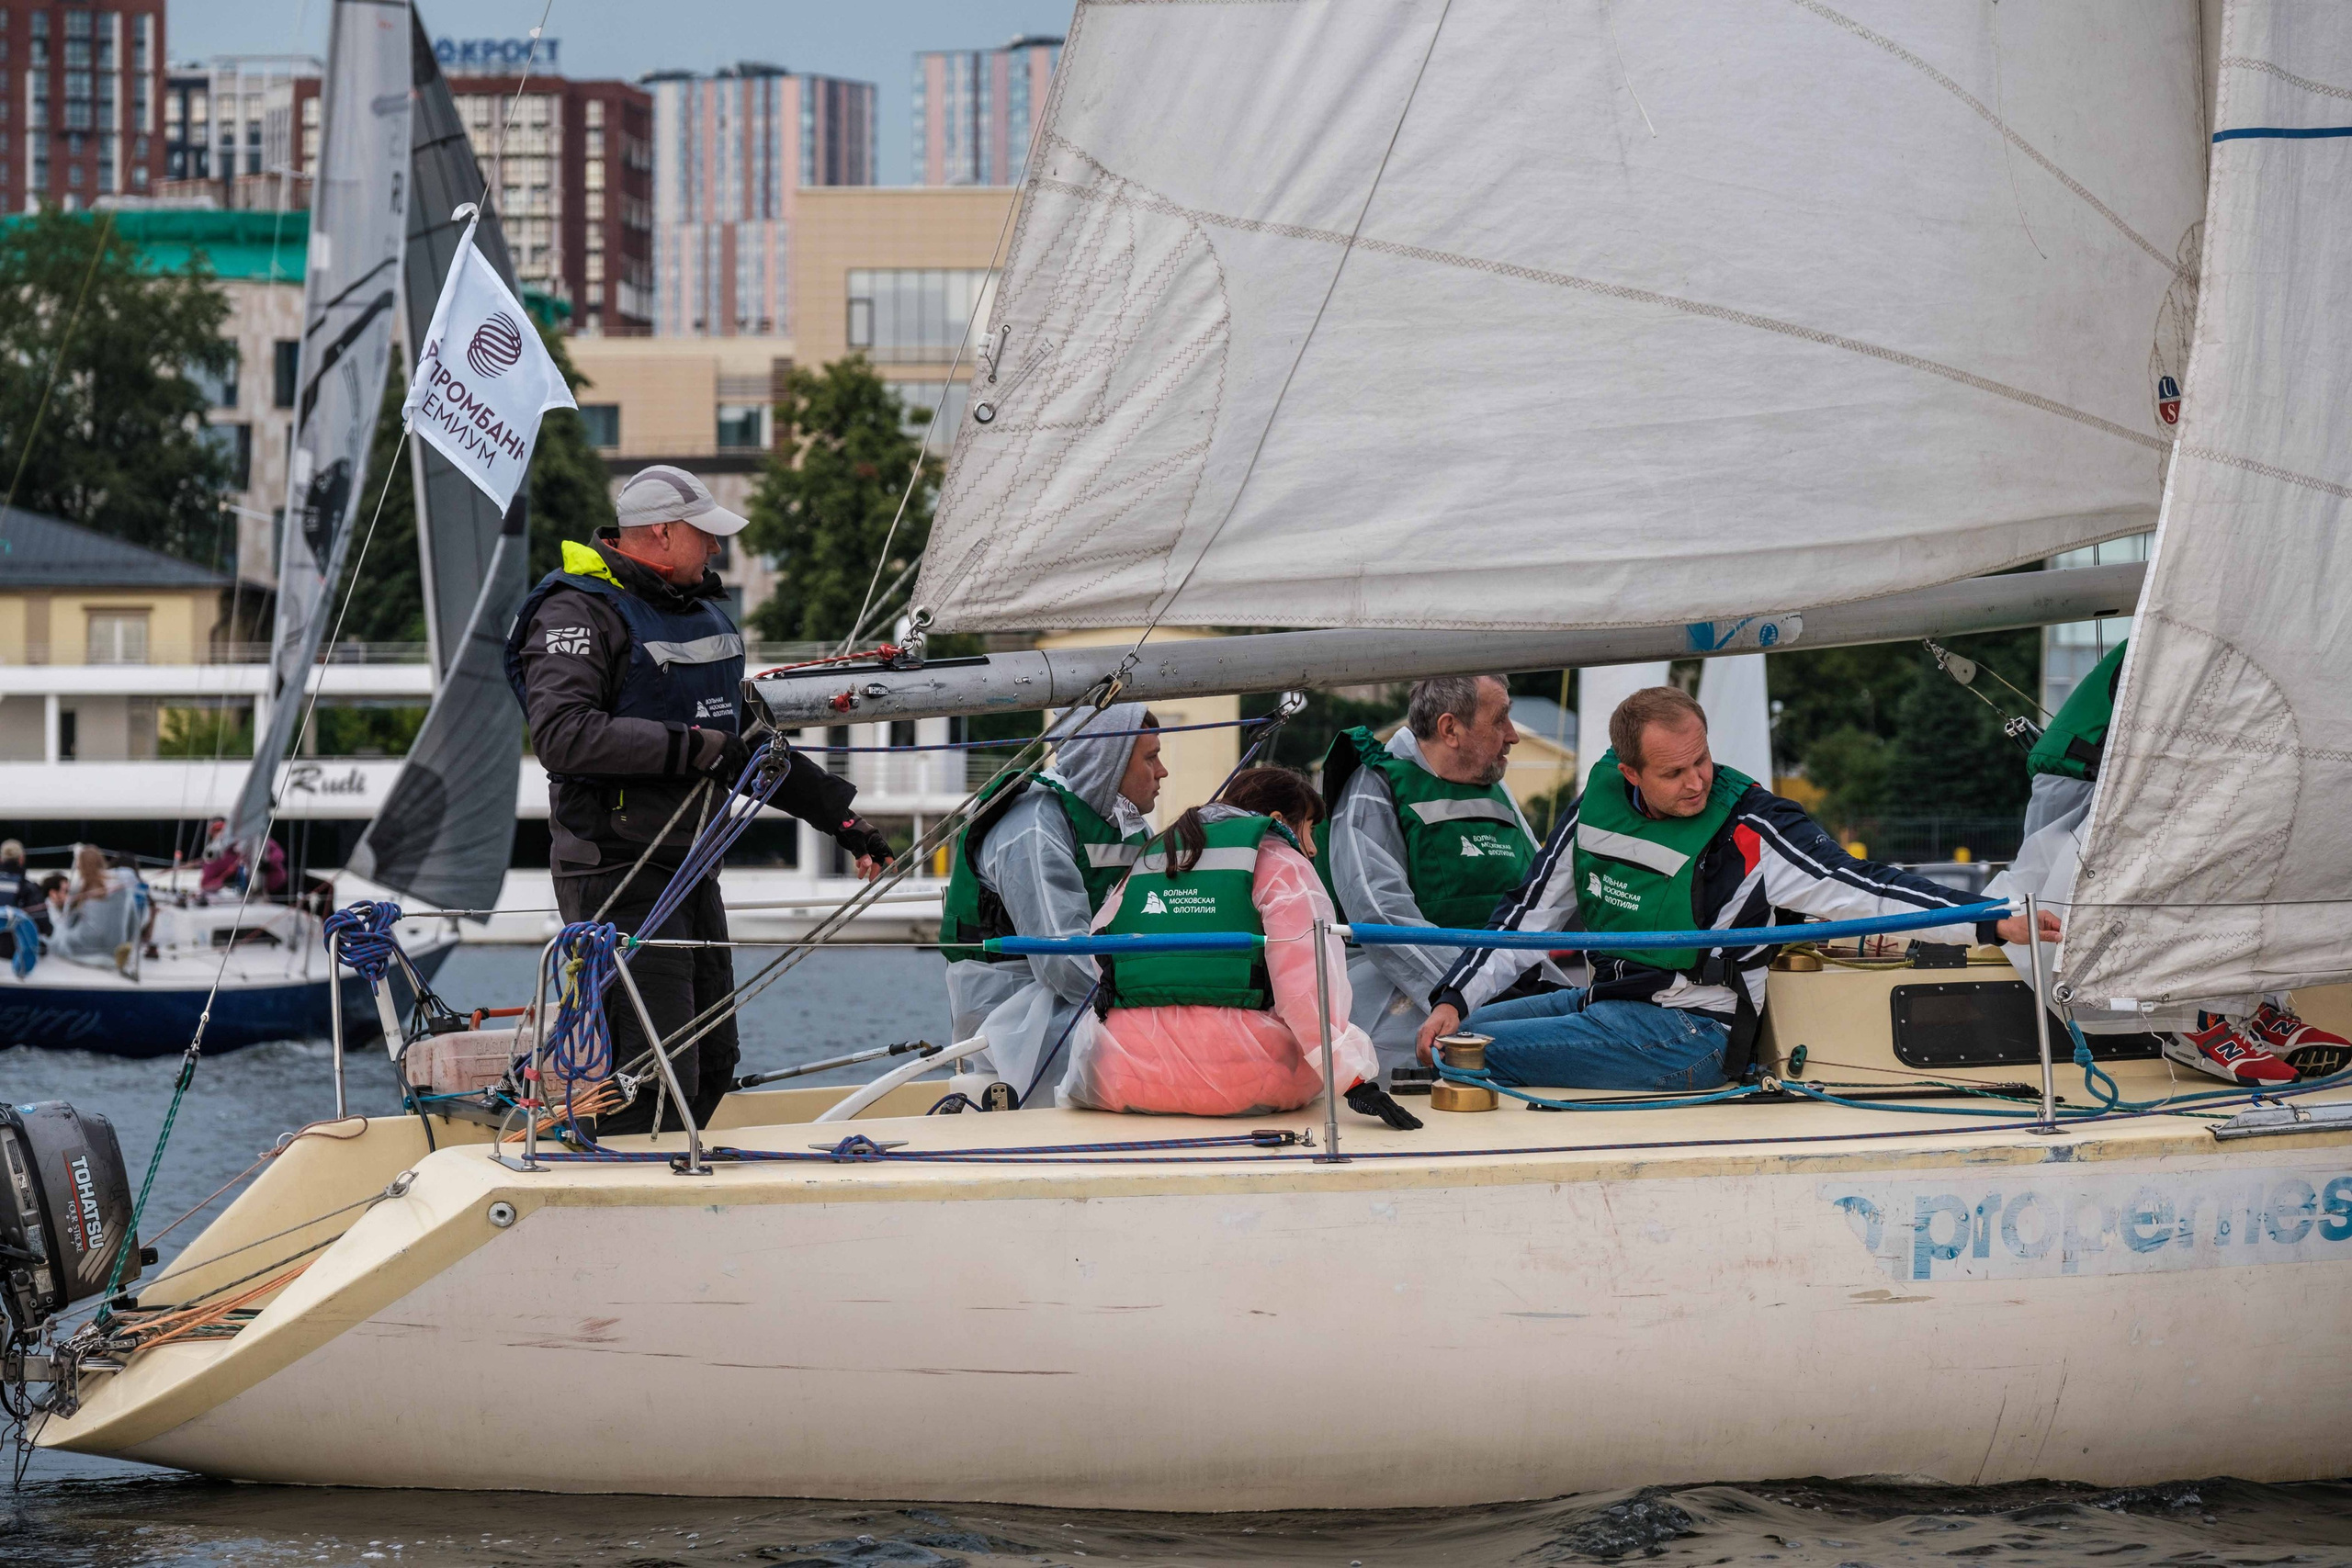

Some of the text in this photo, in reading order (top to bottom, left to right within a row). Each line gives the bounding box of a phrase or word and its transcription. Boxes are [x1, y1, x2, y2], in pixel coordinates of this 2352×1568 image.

[67, 1200, 84, 1253] FOUR STROKE
[72, 1155, 105, 1250] TOHATSU
